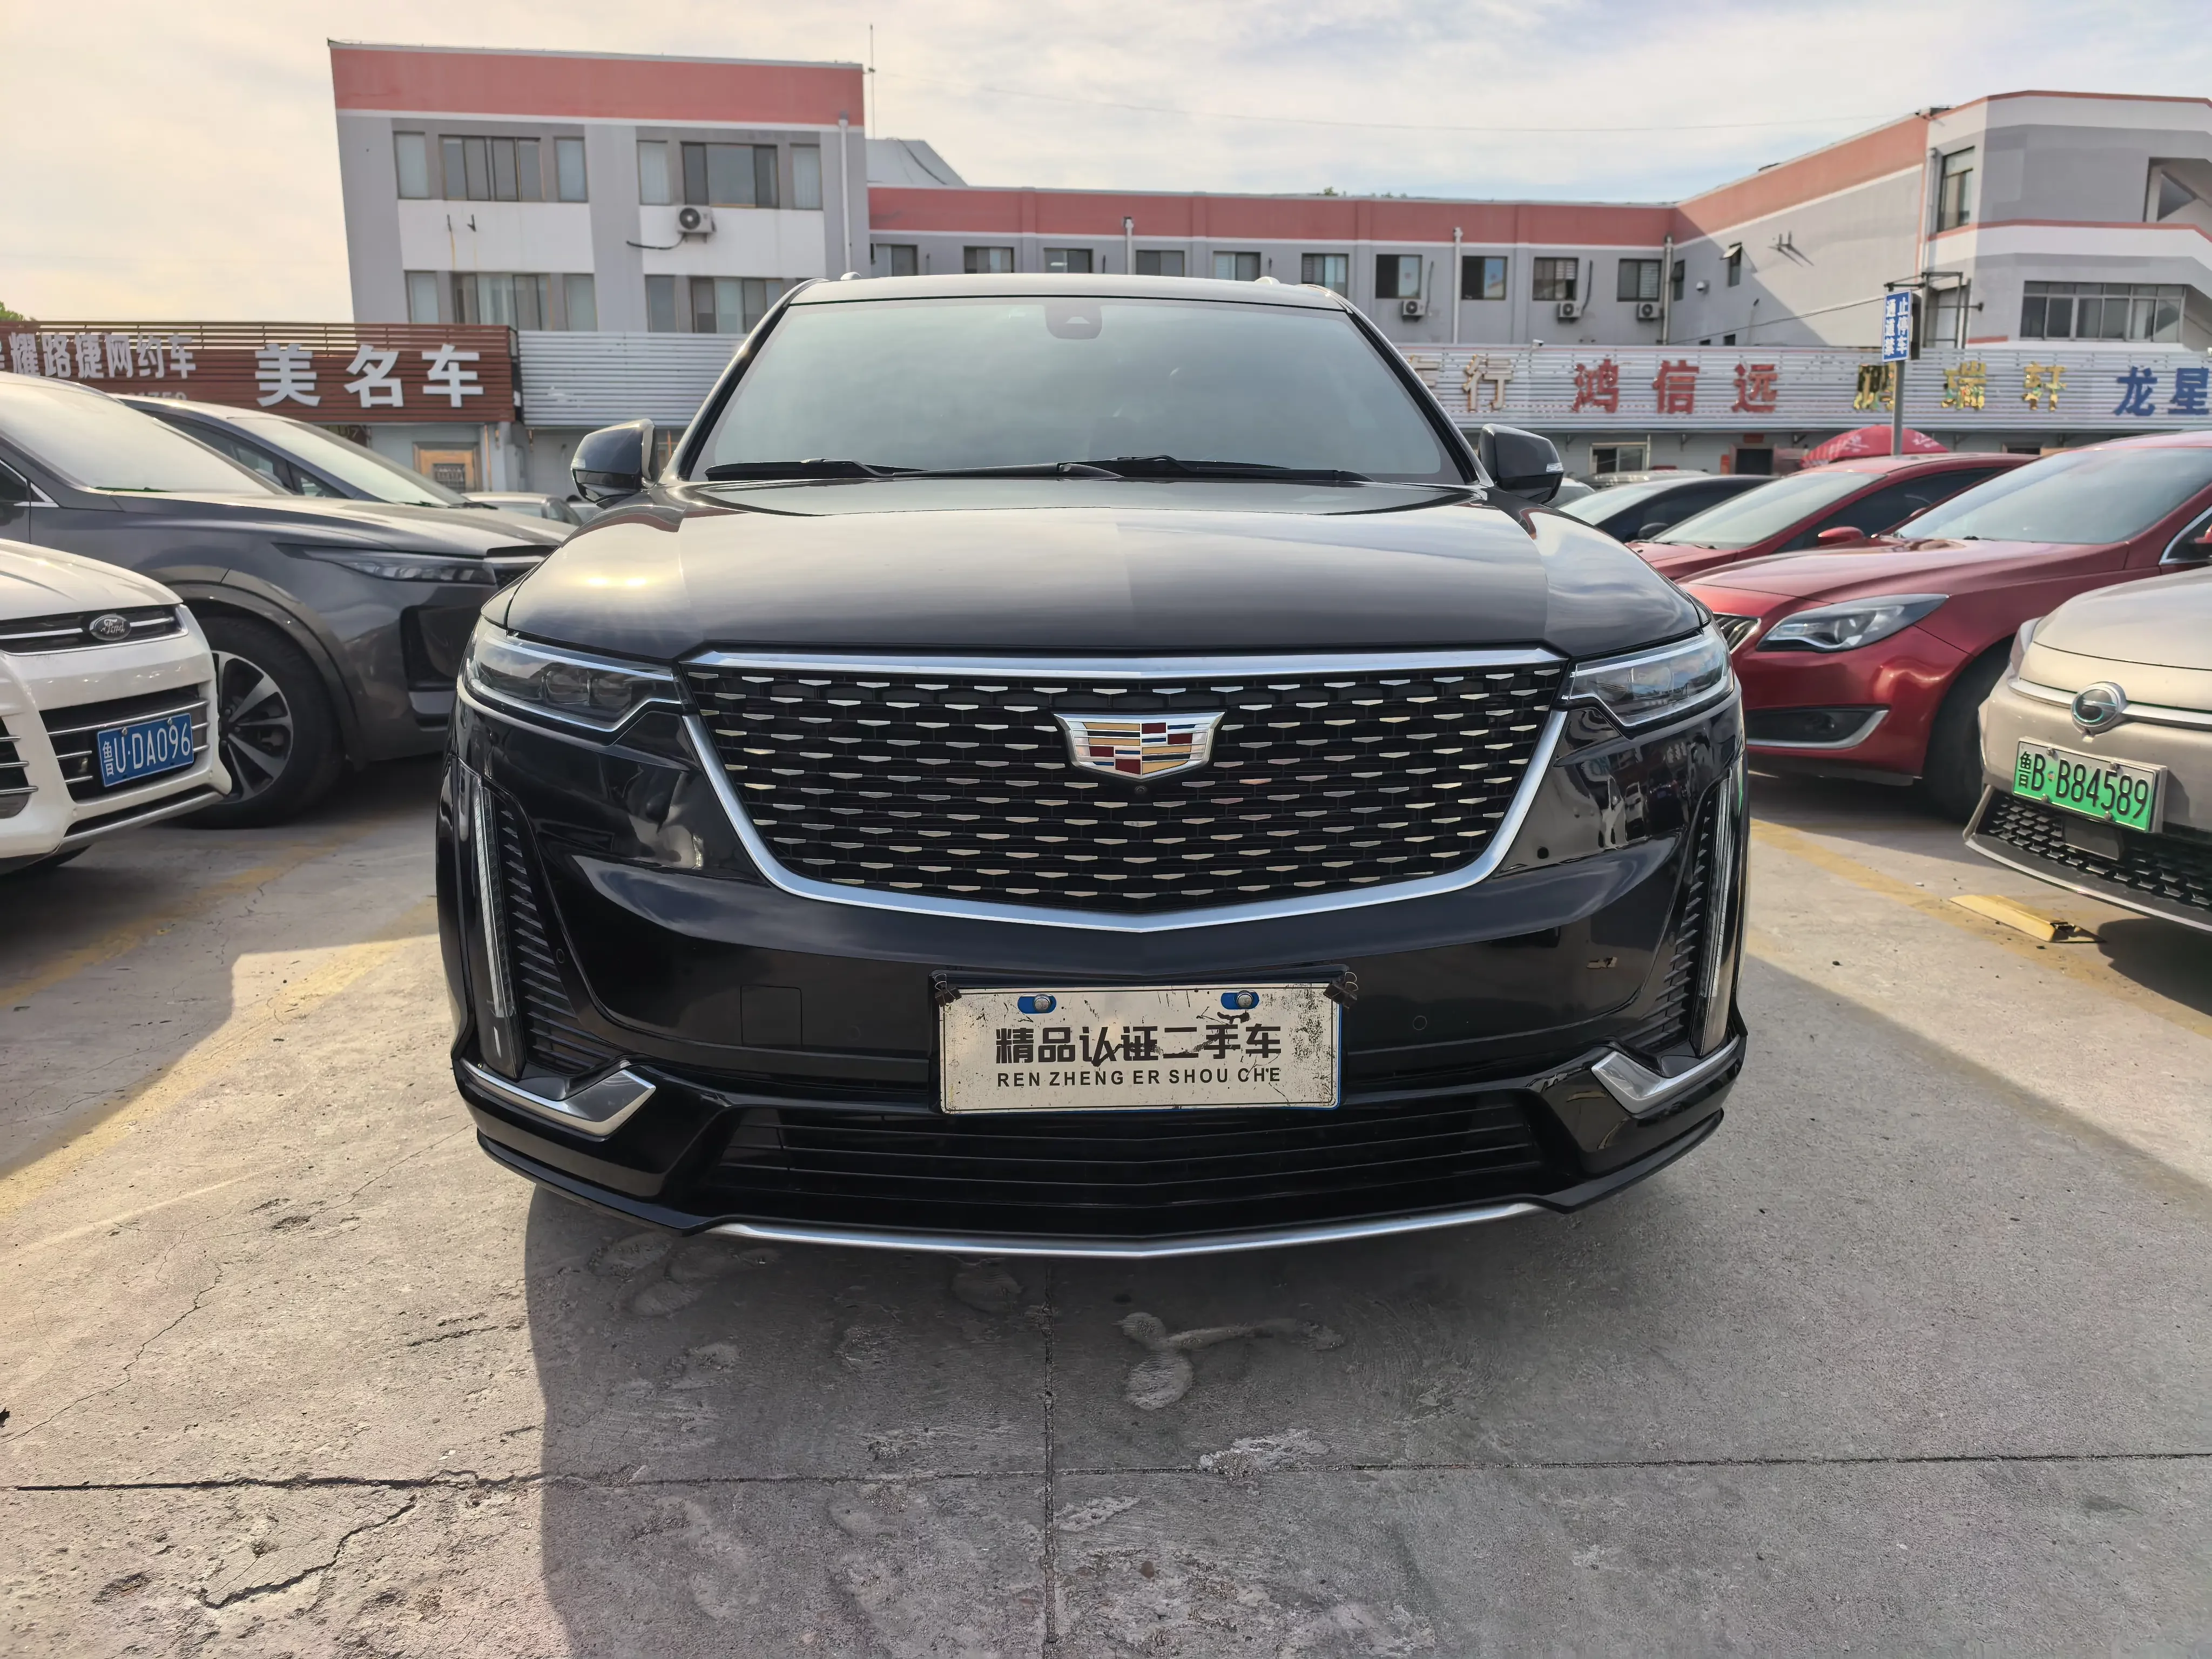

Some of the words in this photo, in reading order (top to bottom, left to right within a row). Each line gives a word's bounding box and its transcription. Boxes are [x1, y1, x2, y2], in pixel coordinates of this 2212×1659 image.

[0, 331, 196, 379] 耀路捷网约车
[255, 343, 483, 408] 美名车
[1571, 359, 1778, 414] 鸿信远
[2113, 366, 2210, 416] 龙星
[996, 1023, 1282, 1064] 精品认证二手车
[997, 1071, 1040, 1087] REN
[1049, 1070, 1124, 1085] ZHENG
[1133, 1070, 1160, 1084] ER
[1169, 1068, 1228, 1084] SHOU
[1237, 1067, 1280, 1082] CHE
